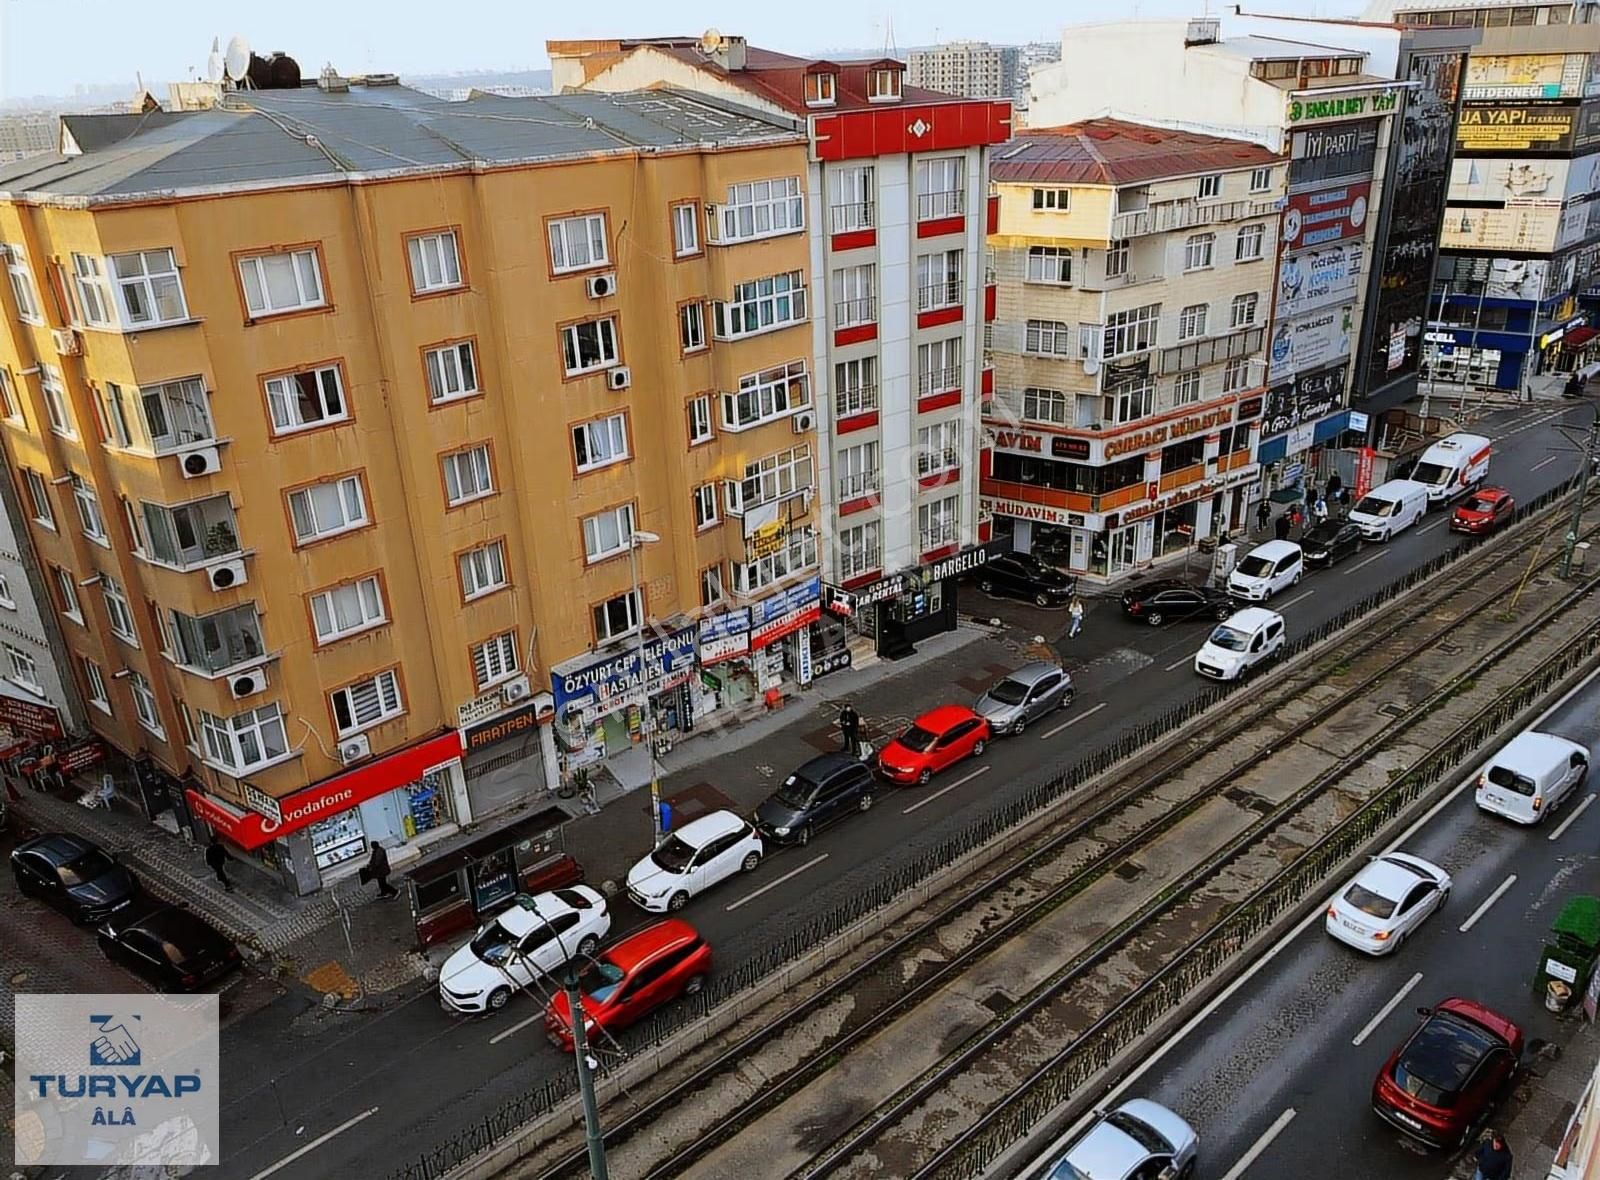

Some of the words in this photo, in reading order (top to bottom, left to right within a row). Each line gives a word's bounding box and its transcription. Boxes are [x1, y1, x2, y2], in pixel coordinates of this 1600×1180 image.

[1487, 109, 1527, 124] YAPI
[1306, 131, 1323, 158] İYİ
[1324, 129, 1358, 157] PARTİ
[995, 430, 1042, 452] AVİM
[995, 501, 1057, 522] MÜDAVİM
[933, 549, 985, 581] BARGELLO
[857, 594, 871, 607] AR
[872, 583, 902, 602] RENTAL
[565, 662, 612, 694] ÖZYURT
[615, 654, 637, 674] CEP
[642, 631, 694, 662] ELEFONU
[471, 712, 534, 747] FIRATPEN
[284, 788, 353, 823] vodafone
